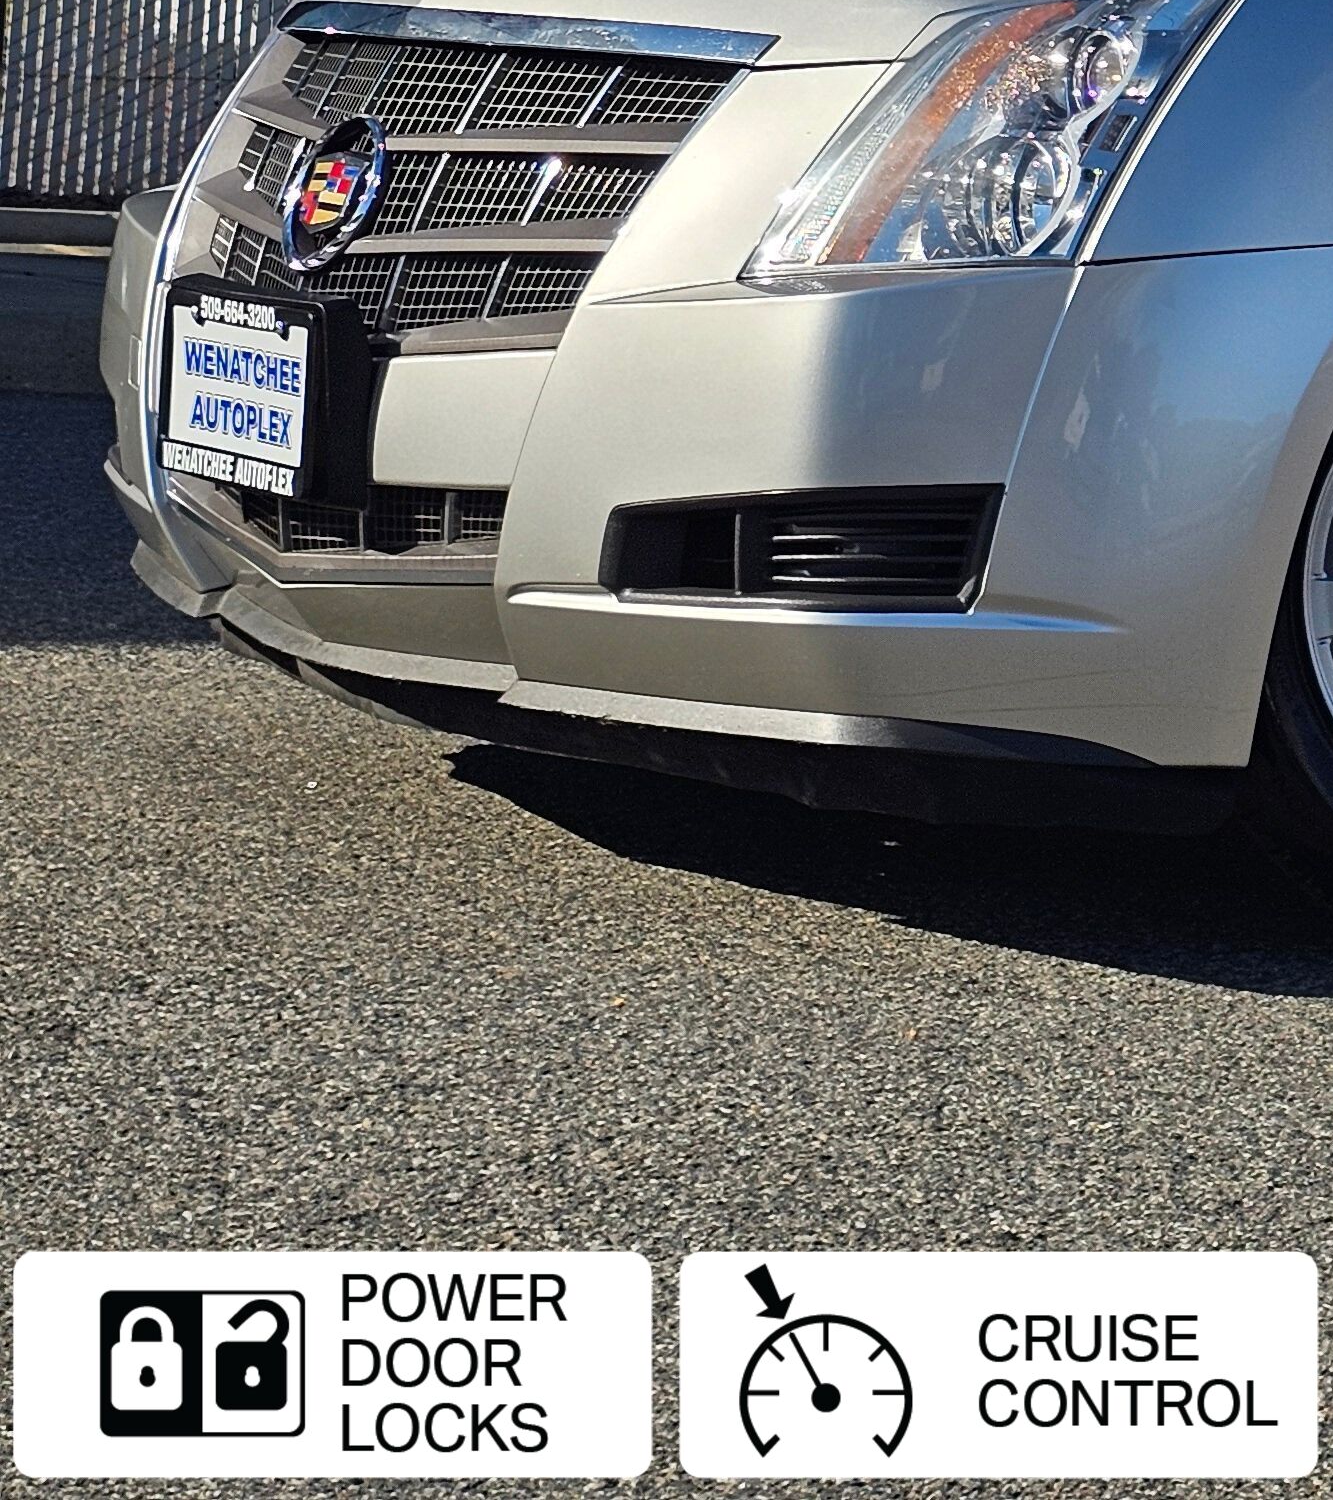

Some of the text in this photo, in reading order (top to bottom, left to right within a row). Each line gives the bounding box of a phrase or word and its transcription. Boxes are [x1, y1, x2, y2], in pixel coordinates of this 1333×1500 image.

[200, 295, 275, 330] 509-664-3200
[183, 337, 302, 396] WENATCHEE
[189, 392, 293, 449] AUTOPLEX
[162, 441, 295, 497] WENATCHEE AUTOPLEX
